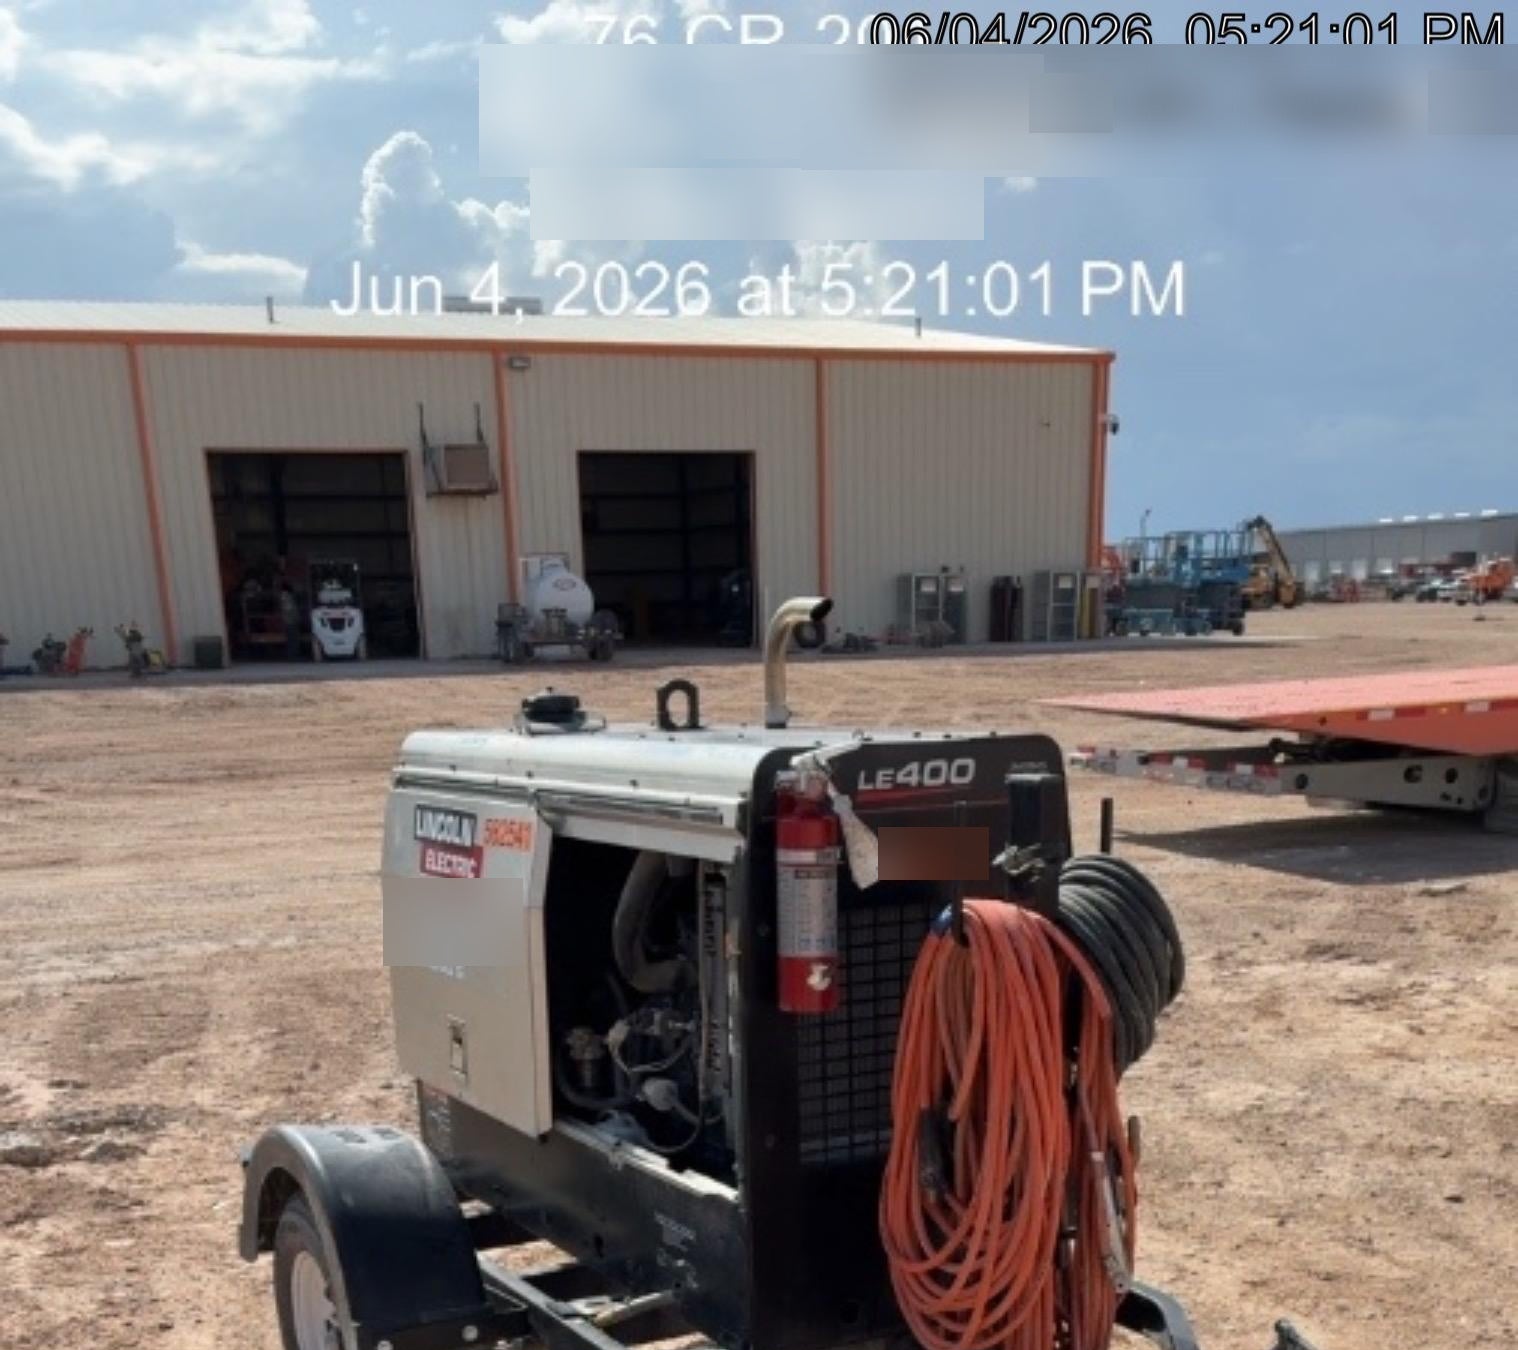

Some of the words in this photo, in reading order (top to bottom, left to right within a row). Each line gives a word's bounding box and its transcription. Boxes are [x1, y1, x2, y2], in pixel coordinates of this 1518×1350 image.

[857, 757, 977, 791] LE400
[416, 808, 475, 847] LINCOLN
[424, 847, 479, 878] ELECTRIC
